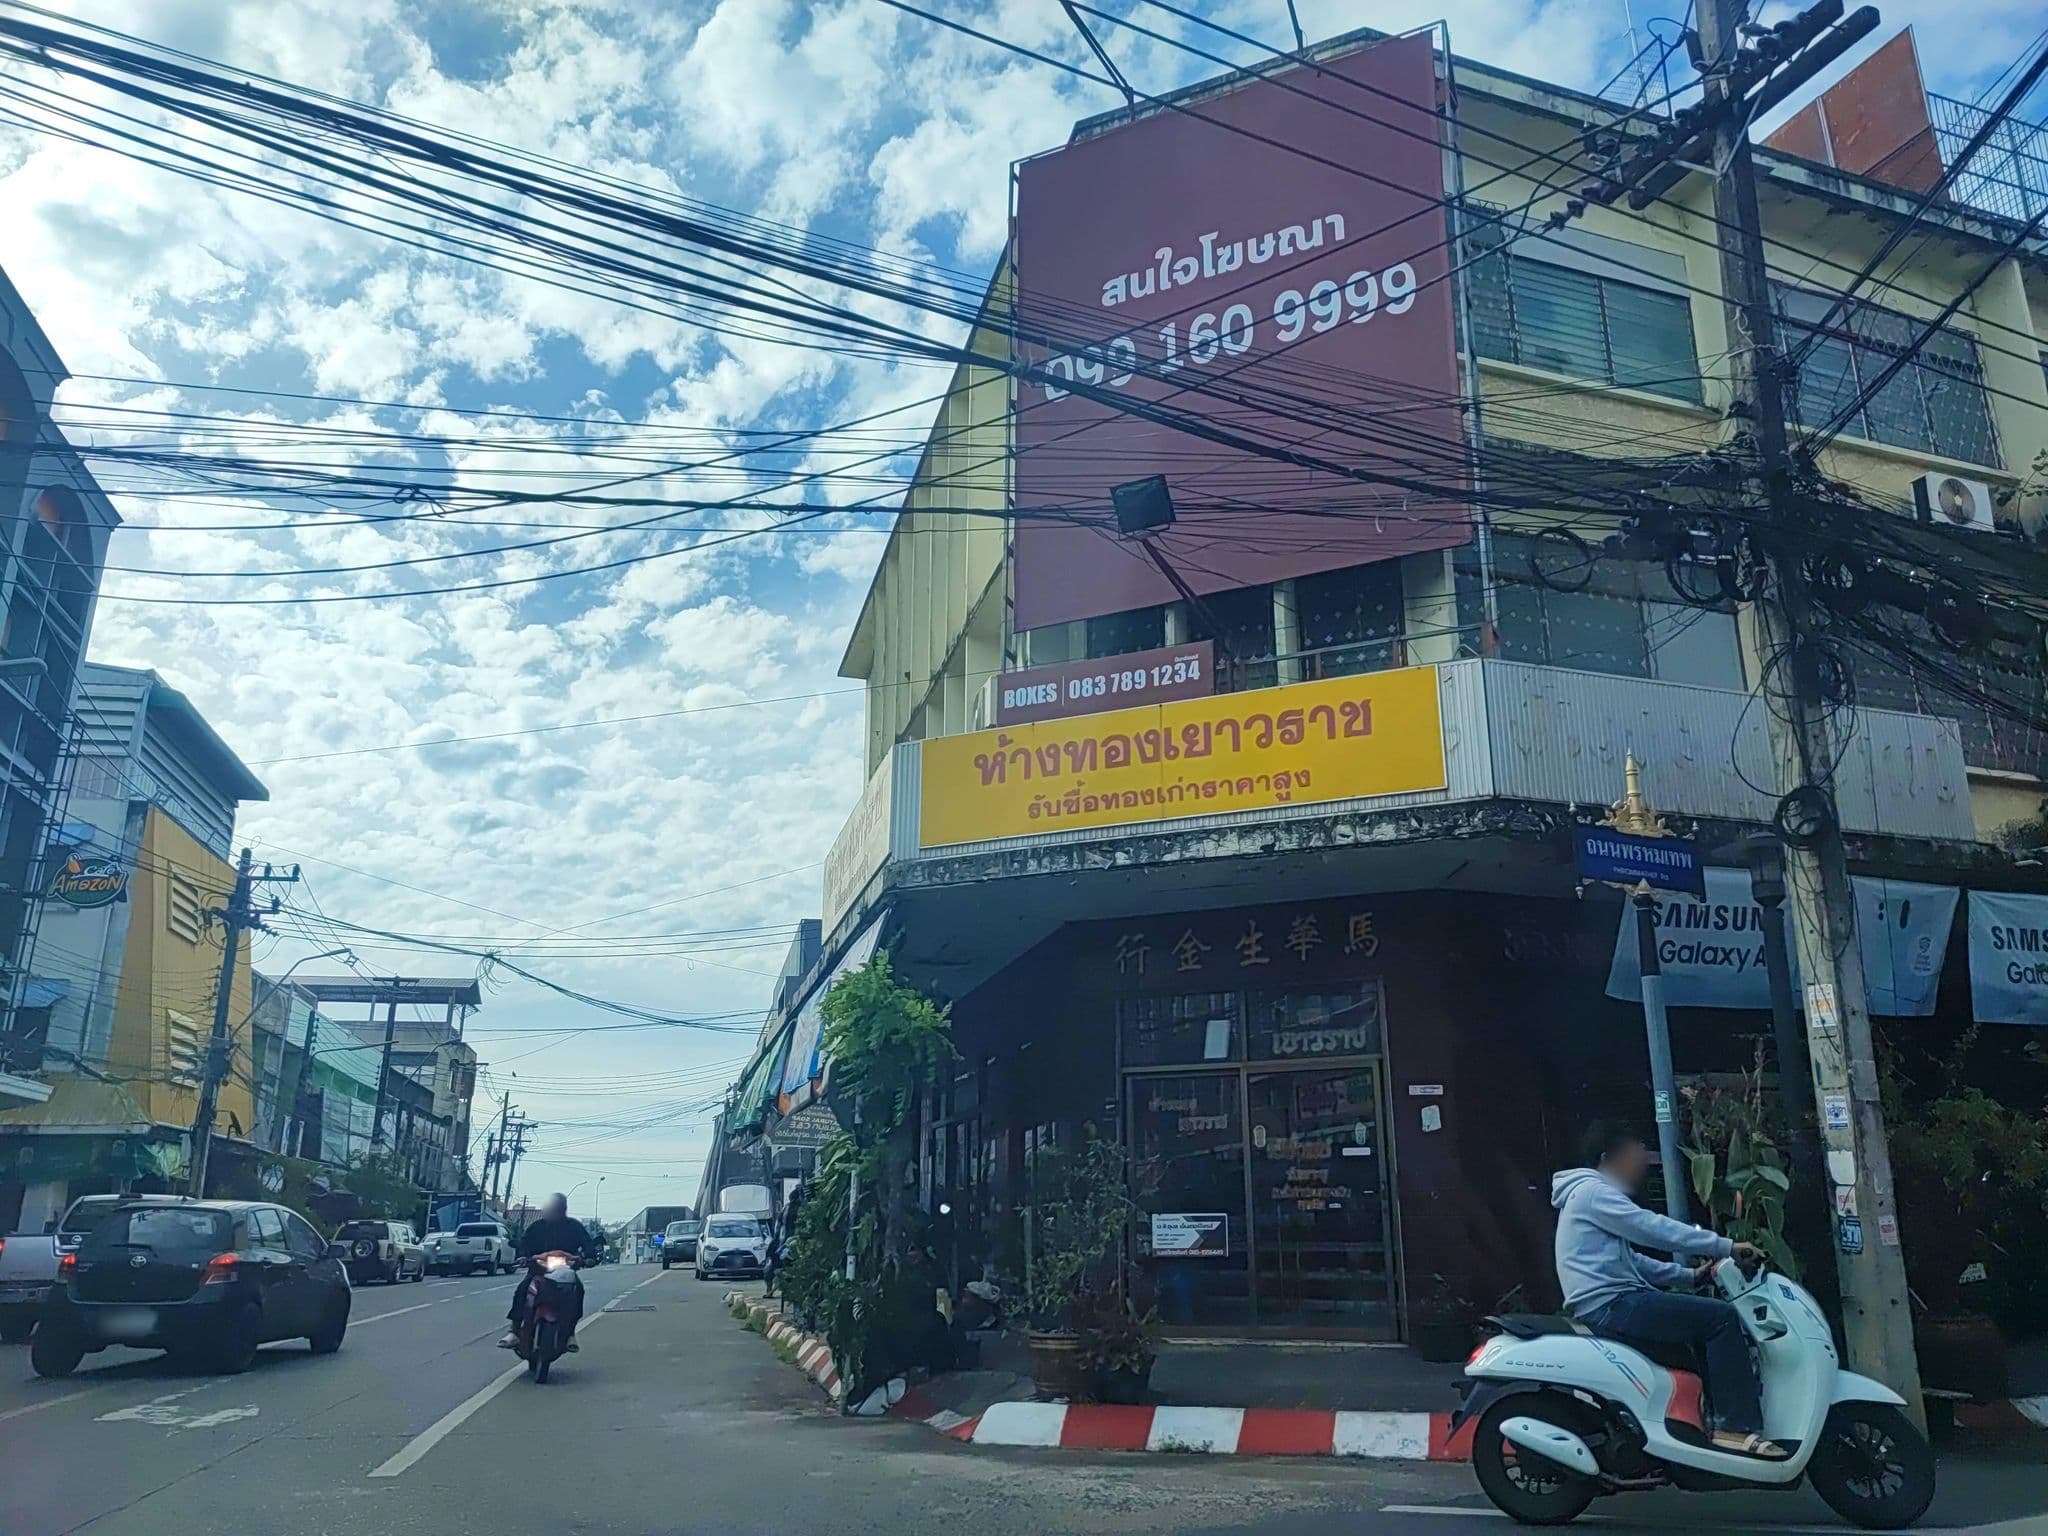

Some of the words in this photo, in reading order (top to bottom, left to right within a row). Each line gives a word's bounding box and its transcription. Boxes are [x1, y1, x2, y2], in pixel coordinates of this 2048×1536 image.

[1101, 213, 1345, 306] สนใจโฆษณา
[1159, 304, 1254, 374] 160
[1273, 262, 1417, 342] 9999
[1003, 682, 1057, 709] BOXES
[1068, 673, 1106, 700] 083
[1110, 667, 1147, 696] 789
[1150, 659, 1201, 687] 1234
[974, 698, 1373, 787] ห้างทองเยาวราช
[1028, 768, 1311, 819] รับซื้อทองเก่าราคาสูง
[1586, 838, 1693, 869] ถนนพรหมเทพ
[1649, 901, 1765, 932] SAMSUN
[1659, 939, 1751, 973] Galaxy
